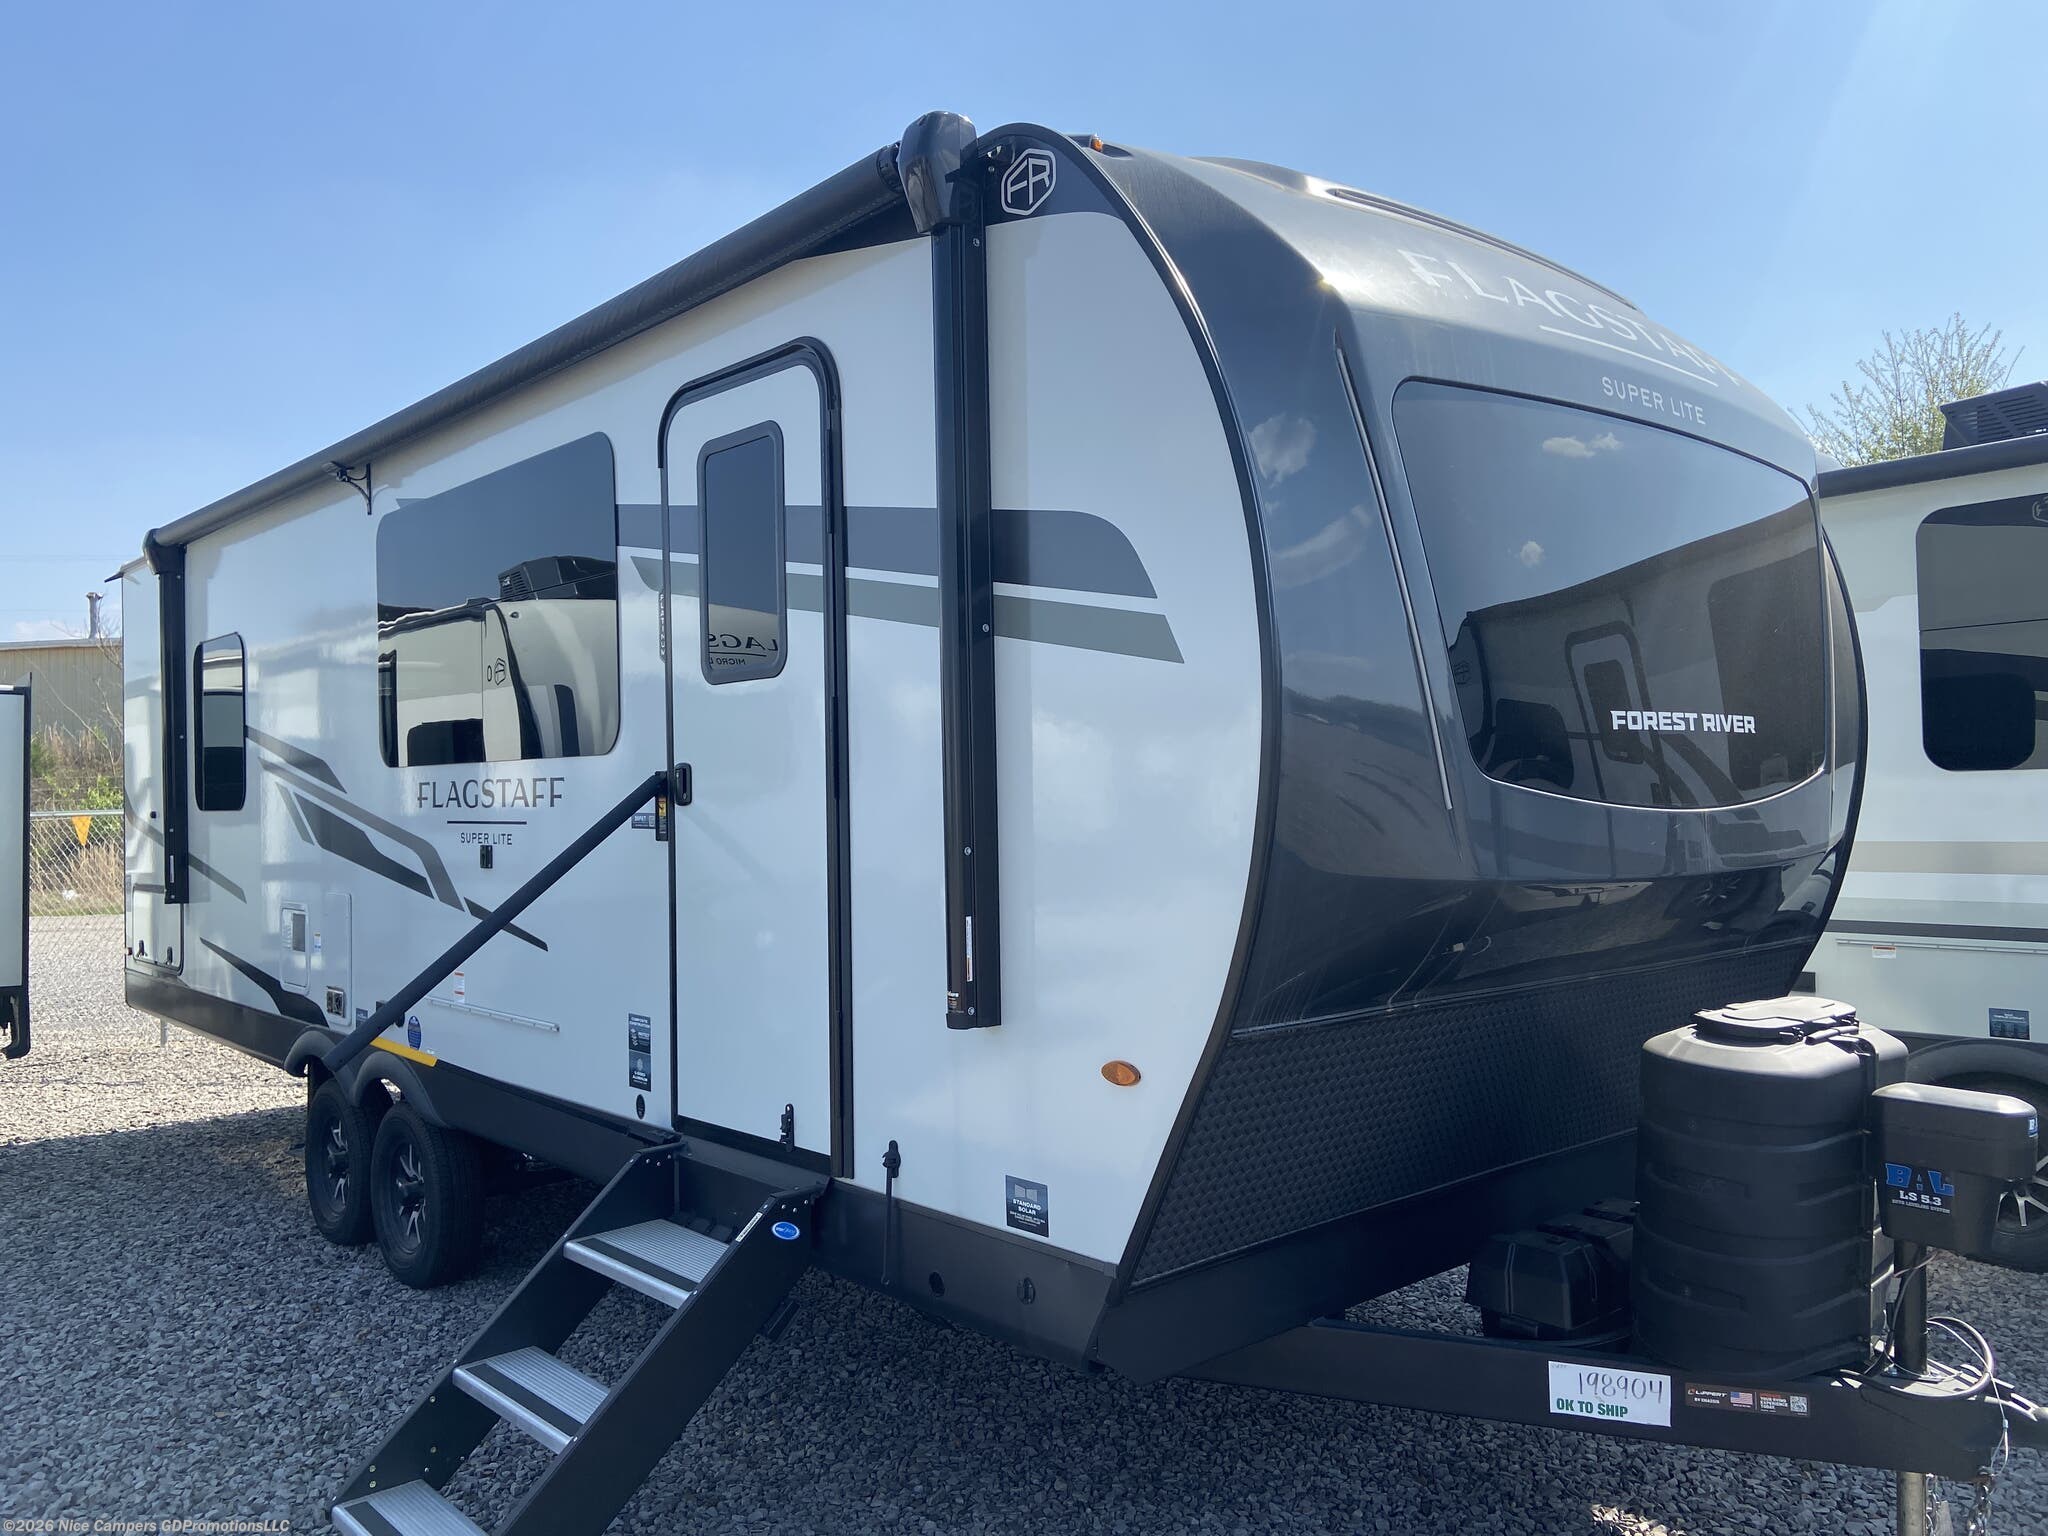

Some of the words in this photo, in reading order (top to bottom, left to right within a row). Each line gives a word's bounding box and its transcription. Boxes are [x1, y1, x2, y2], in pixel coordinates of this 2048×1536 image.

[1602, 376, 1664, 412] SUPER
[1670, 397, 1707, 425] LITE
[1610, 710, 1698, 732] FOREST
[1701, 713, 1757, 734] RIVER
[416, 777, 566, 809] FLAGSTAFF
[460, 832, 490, 845] SUPER
[492, 833, 513, 846] LITE
[1012, 1198, 1042, 1211] STANDARD
[1899, 1190, 1918, 1202] LS
[1920, 1193, 1942, 1207] 5.3
[1018, 1206, 1036, 1216] SOLAR
[1579, 1372, 1663, 1404] 198904
[1556, 1398, 1575, 1412] OK
[1577, 1400, 1594, 1414] TO
[1597, 1403, 1628, 1418] SHIP
